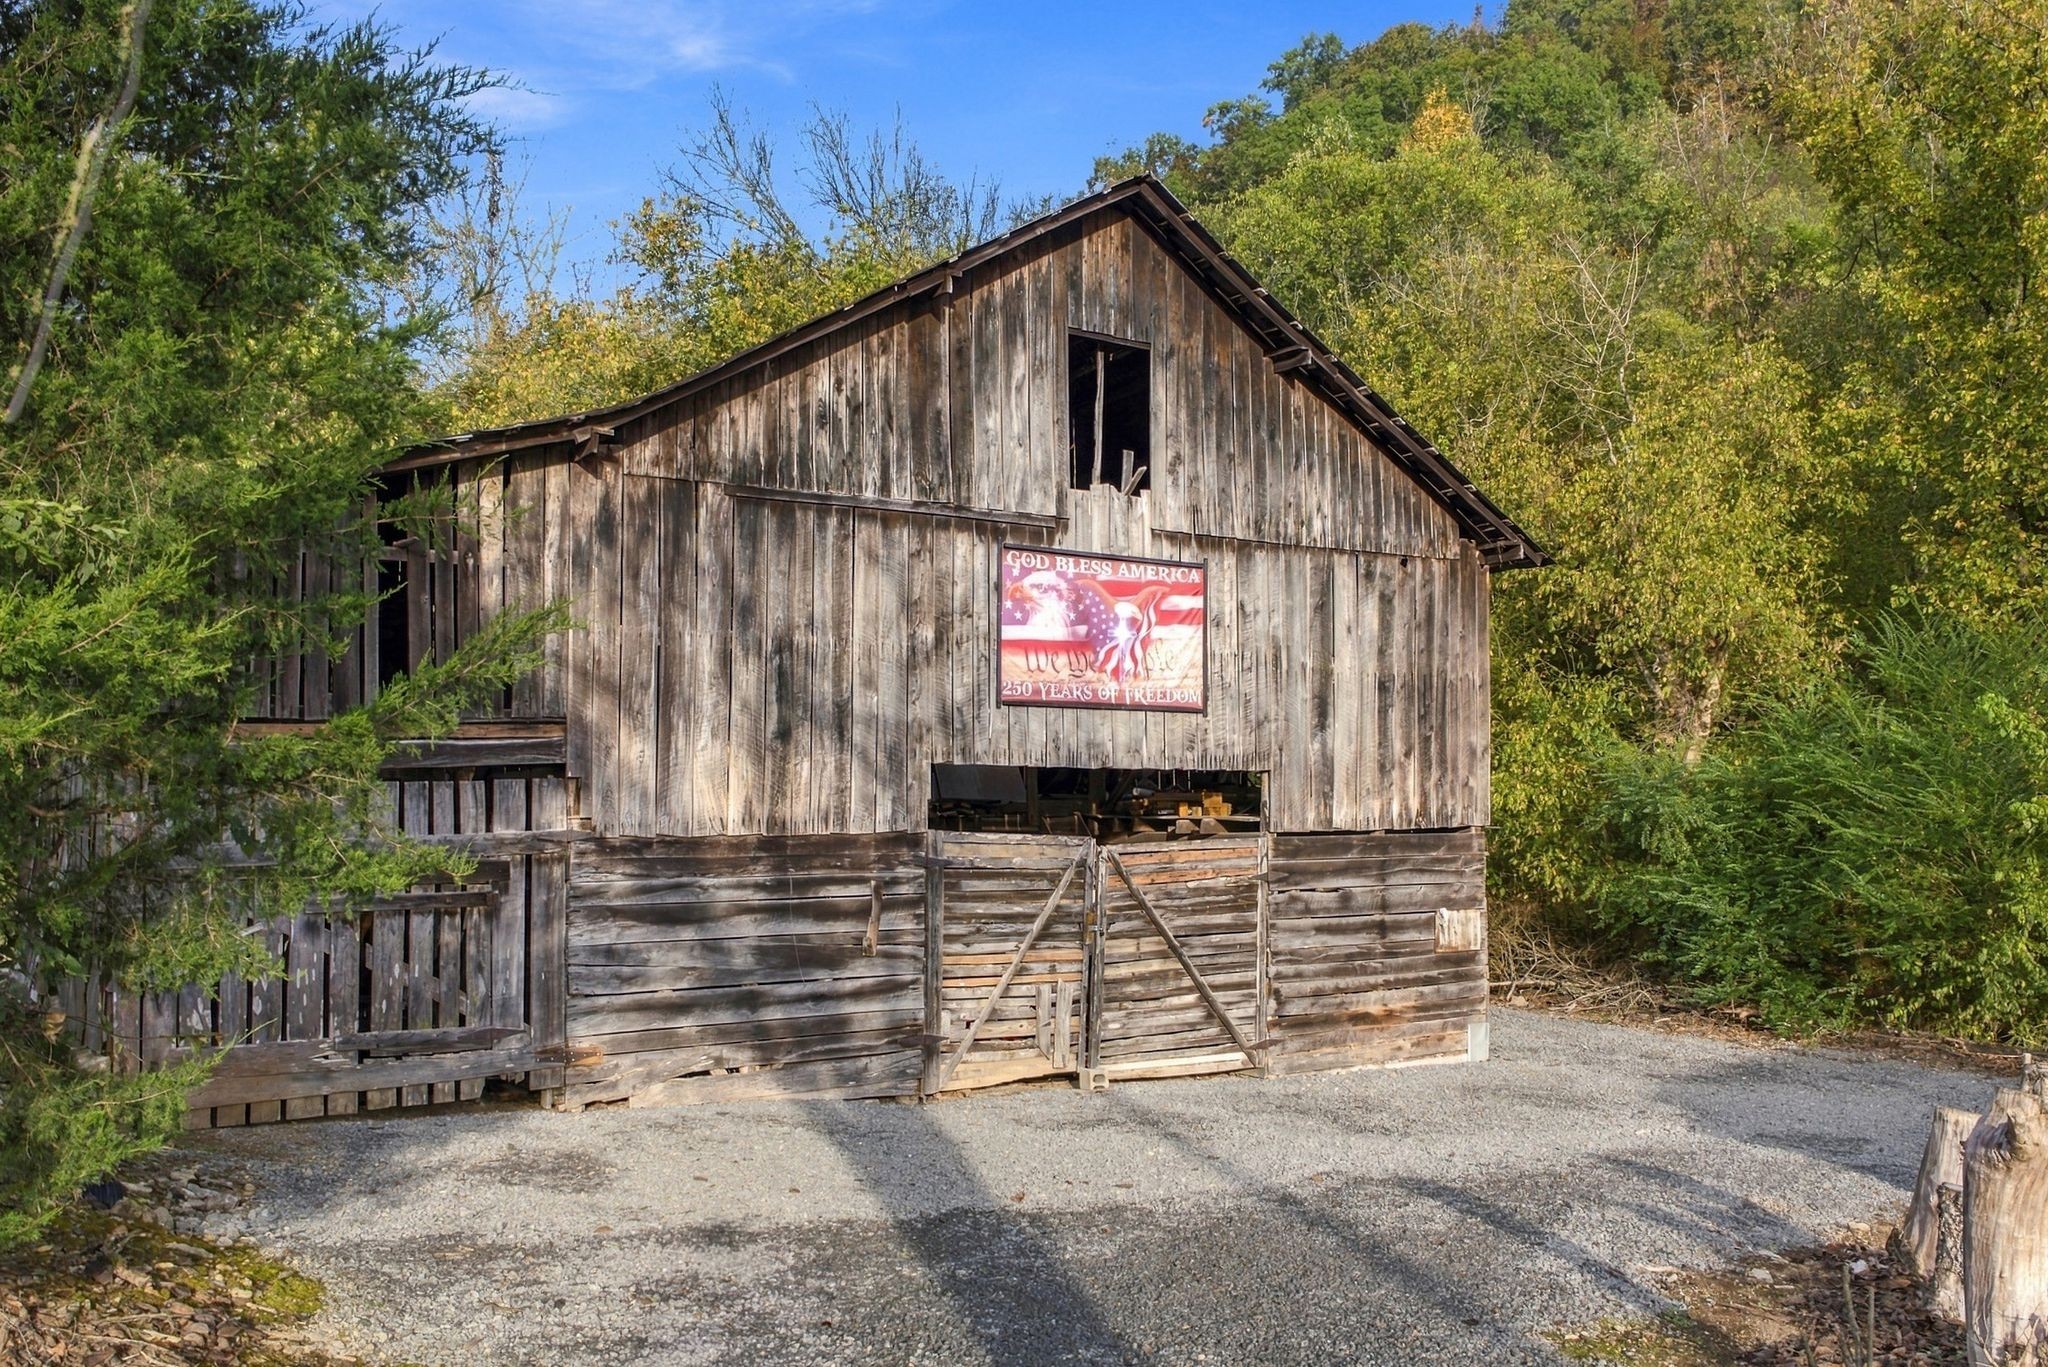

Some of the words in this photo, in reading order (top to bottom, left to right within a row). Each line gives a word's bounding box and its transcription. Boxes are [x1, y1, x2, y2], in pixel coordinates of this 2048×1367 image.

[1006, 550, 1050, 570] GOD
[1055, 556, 1112, 576] BLESS
[1117, 563, 1200, 584] AMERICA
[1002, 680, 1033, 697] 250
[1039, 682, 1093, 702] YEARS
[1097, 687, 1119, 704] OF
[1125, 687, 1202, 706] FREEDOM
